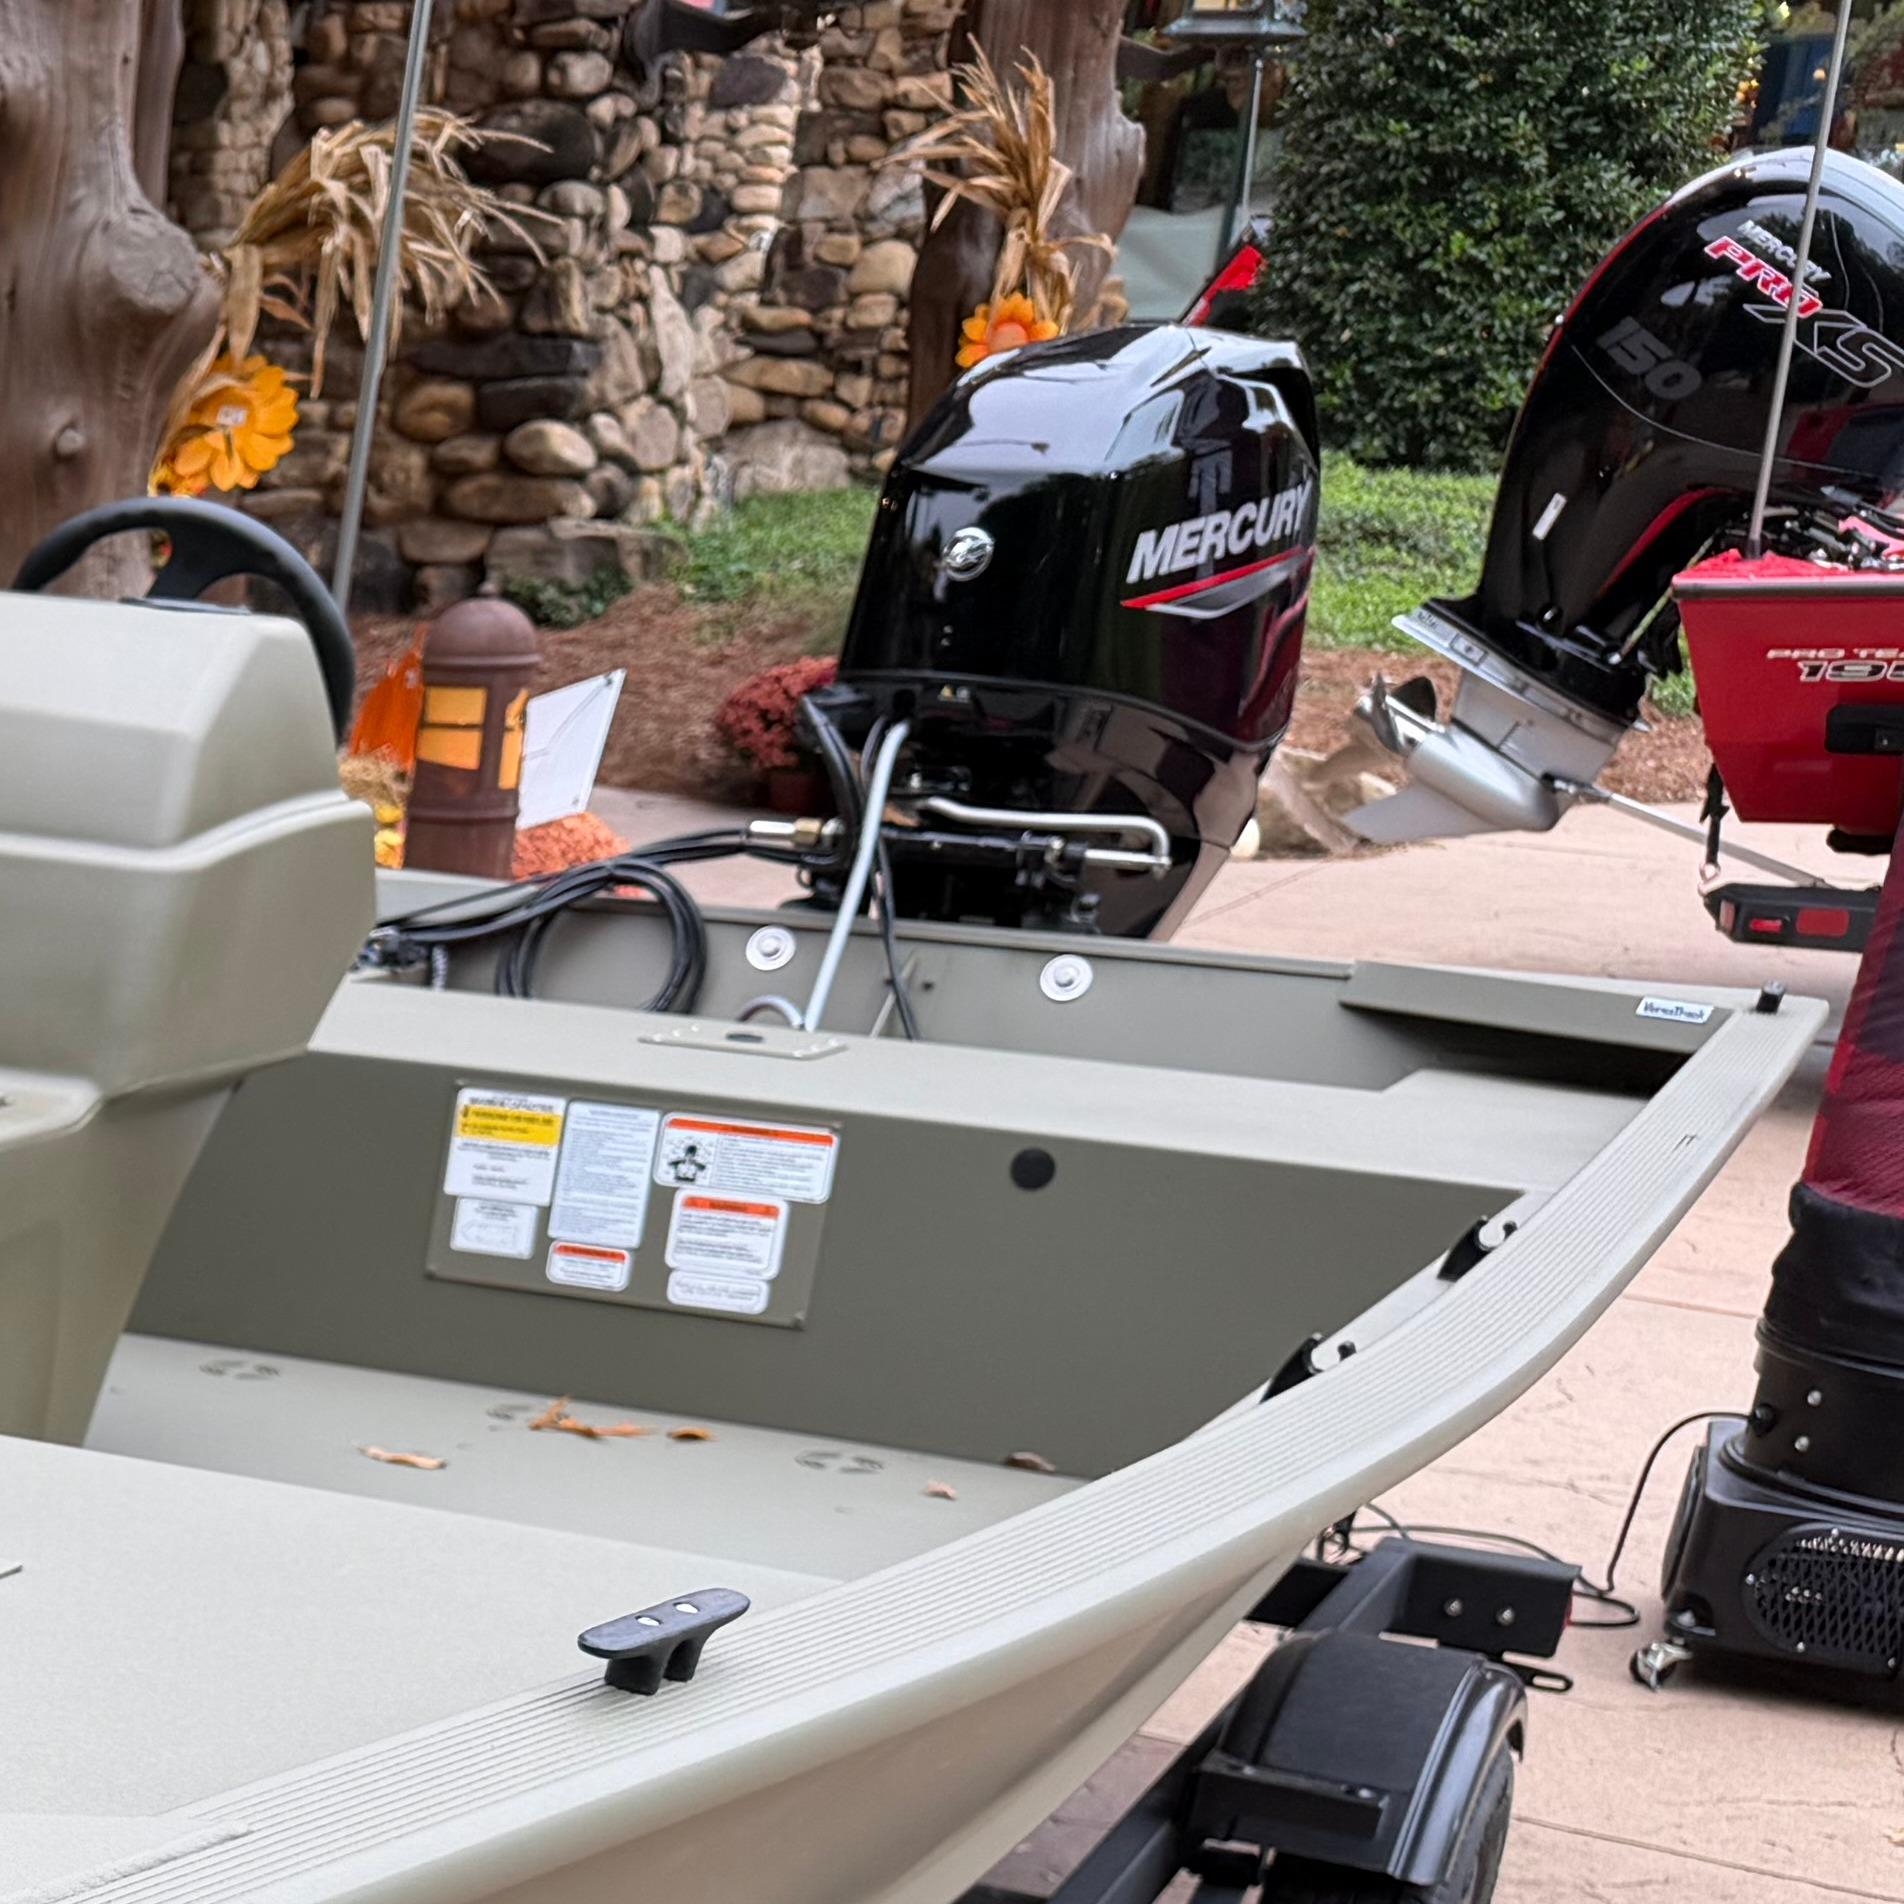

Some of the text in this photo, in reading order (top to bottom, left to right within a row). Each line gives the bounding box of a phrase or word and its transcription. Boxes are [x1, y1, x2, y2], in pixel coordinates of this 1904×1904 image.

[1704, 236, 1823, 318] PRO
[1596, 316, 1702, 400] 150
[1743, 303, 1904, 388] XS
[1126, 475, 1313, 584] MERCURY
